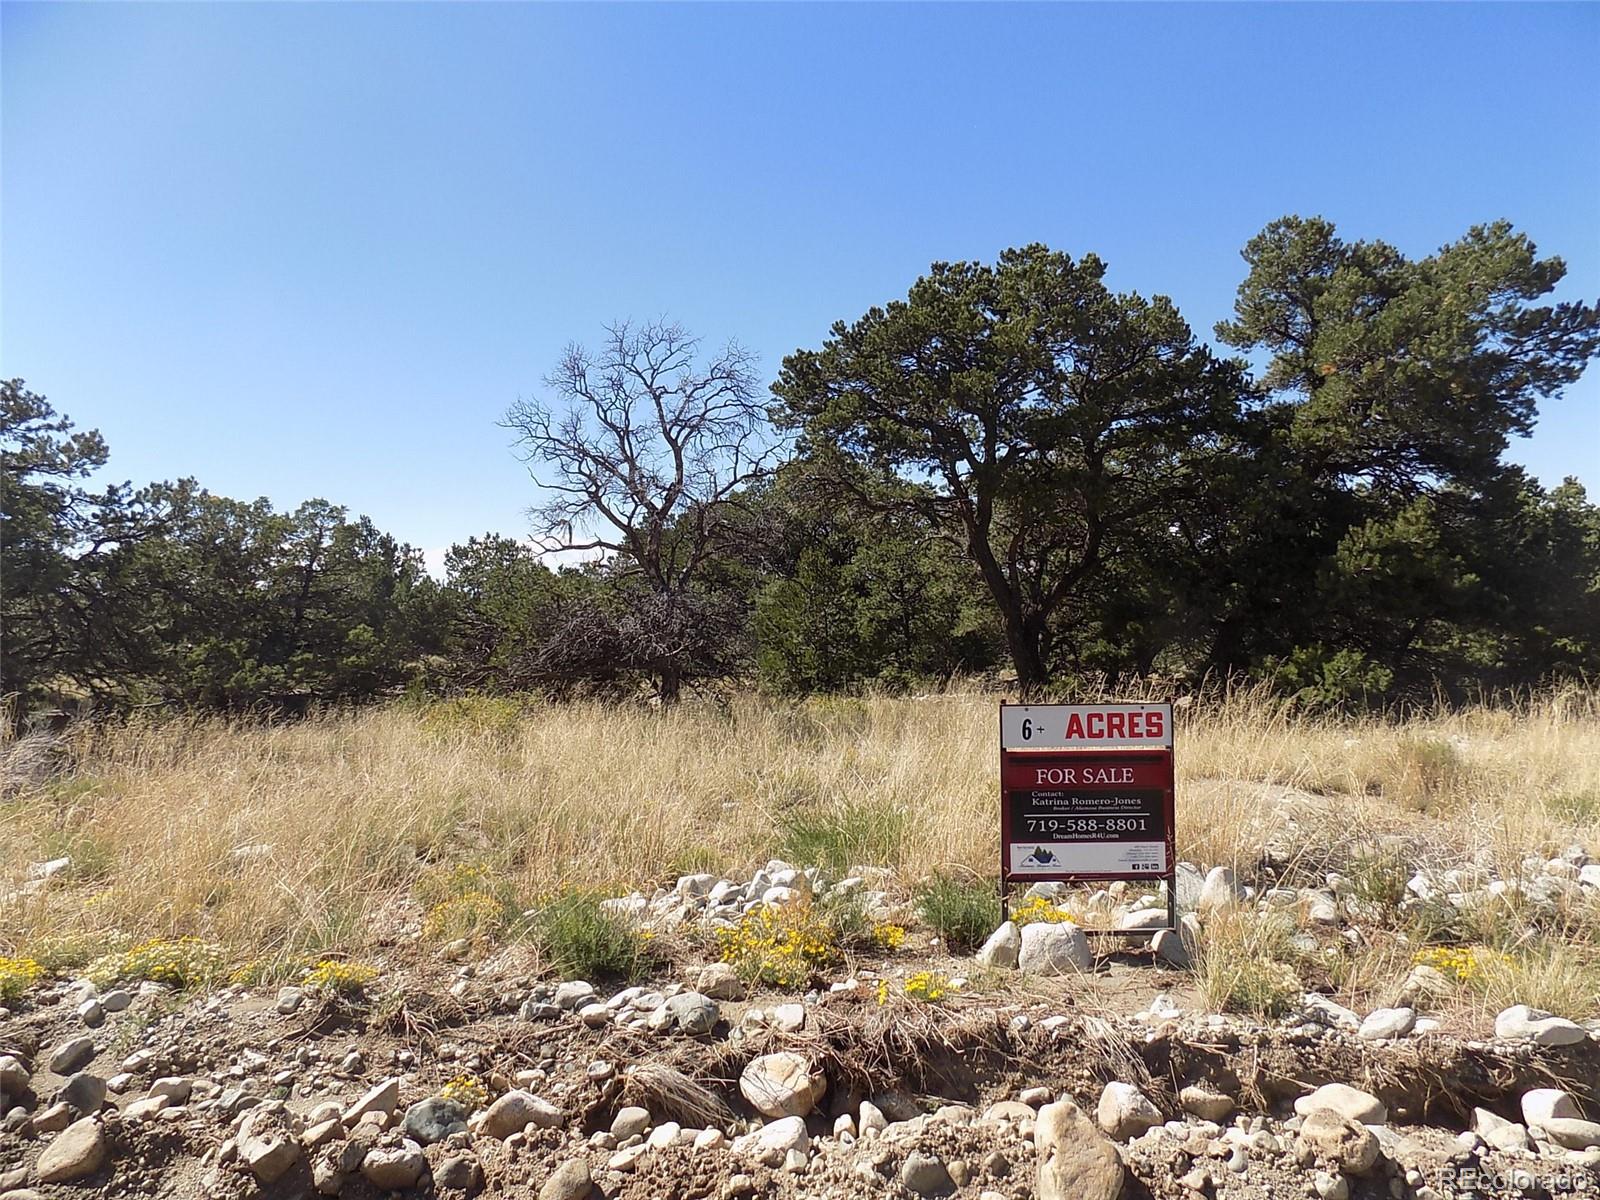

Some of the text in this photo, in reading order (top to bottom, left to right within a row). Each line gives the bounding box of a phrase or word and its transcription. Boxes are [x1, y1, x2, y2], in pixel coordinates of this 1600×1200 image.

[1065, 712, 1164, 740] ACRES
[1036, 768, 1134, 785] FOR SALE
[1032, 796, 1142, 806] Katrina Romero-Jones
[1026, 818, 1147, 832] 719-588-8801
[1052, 832, 1120, 840] DreamHomesR4U.com
